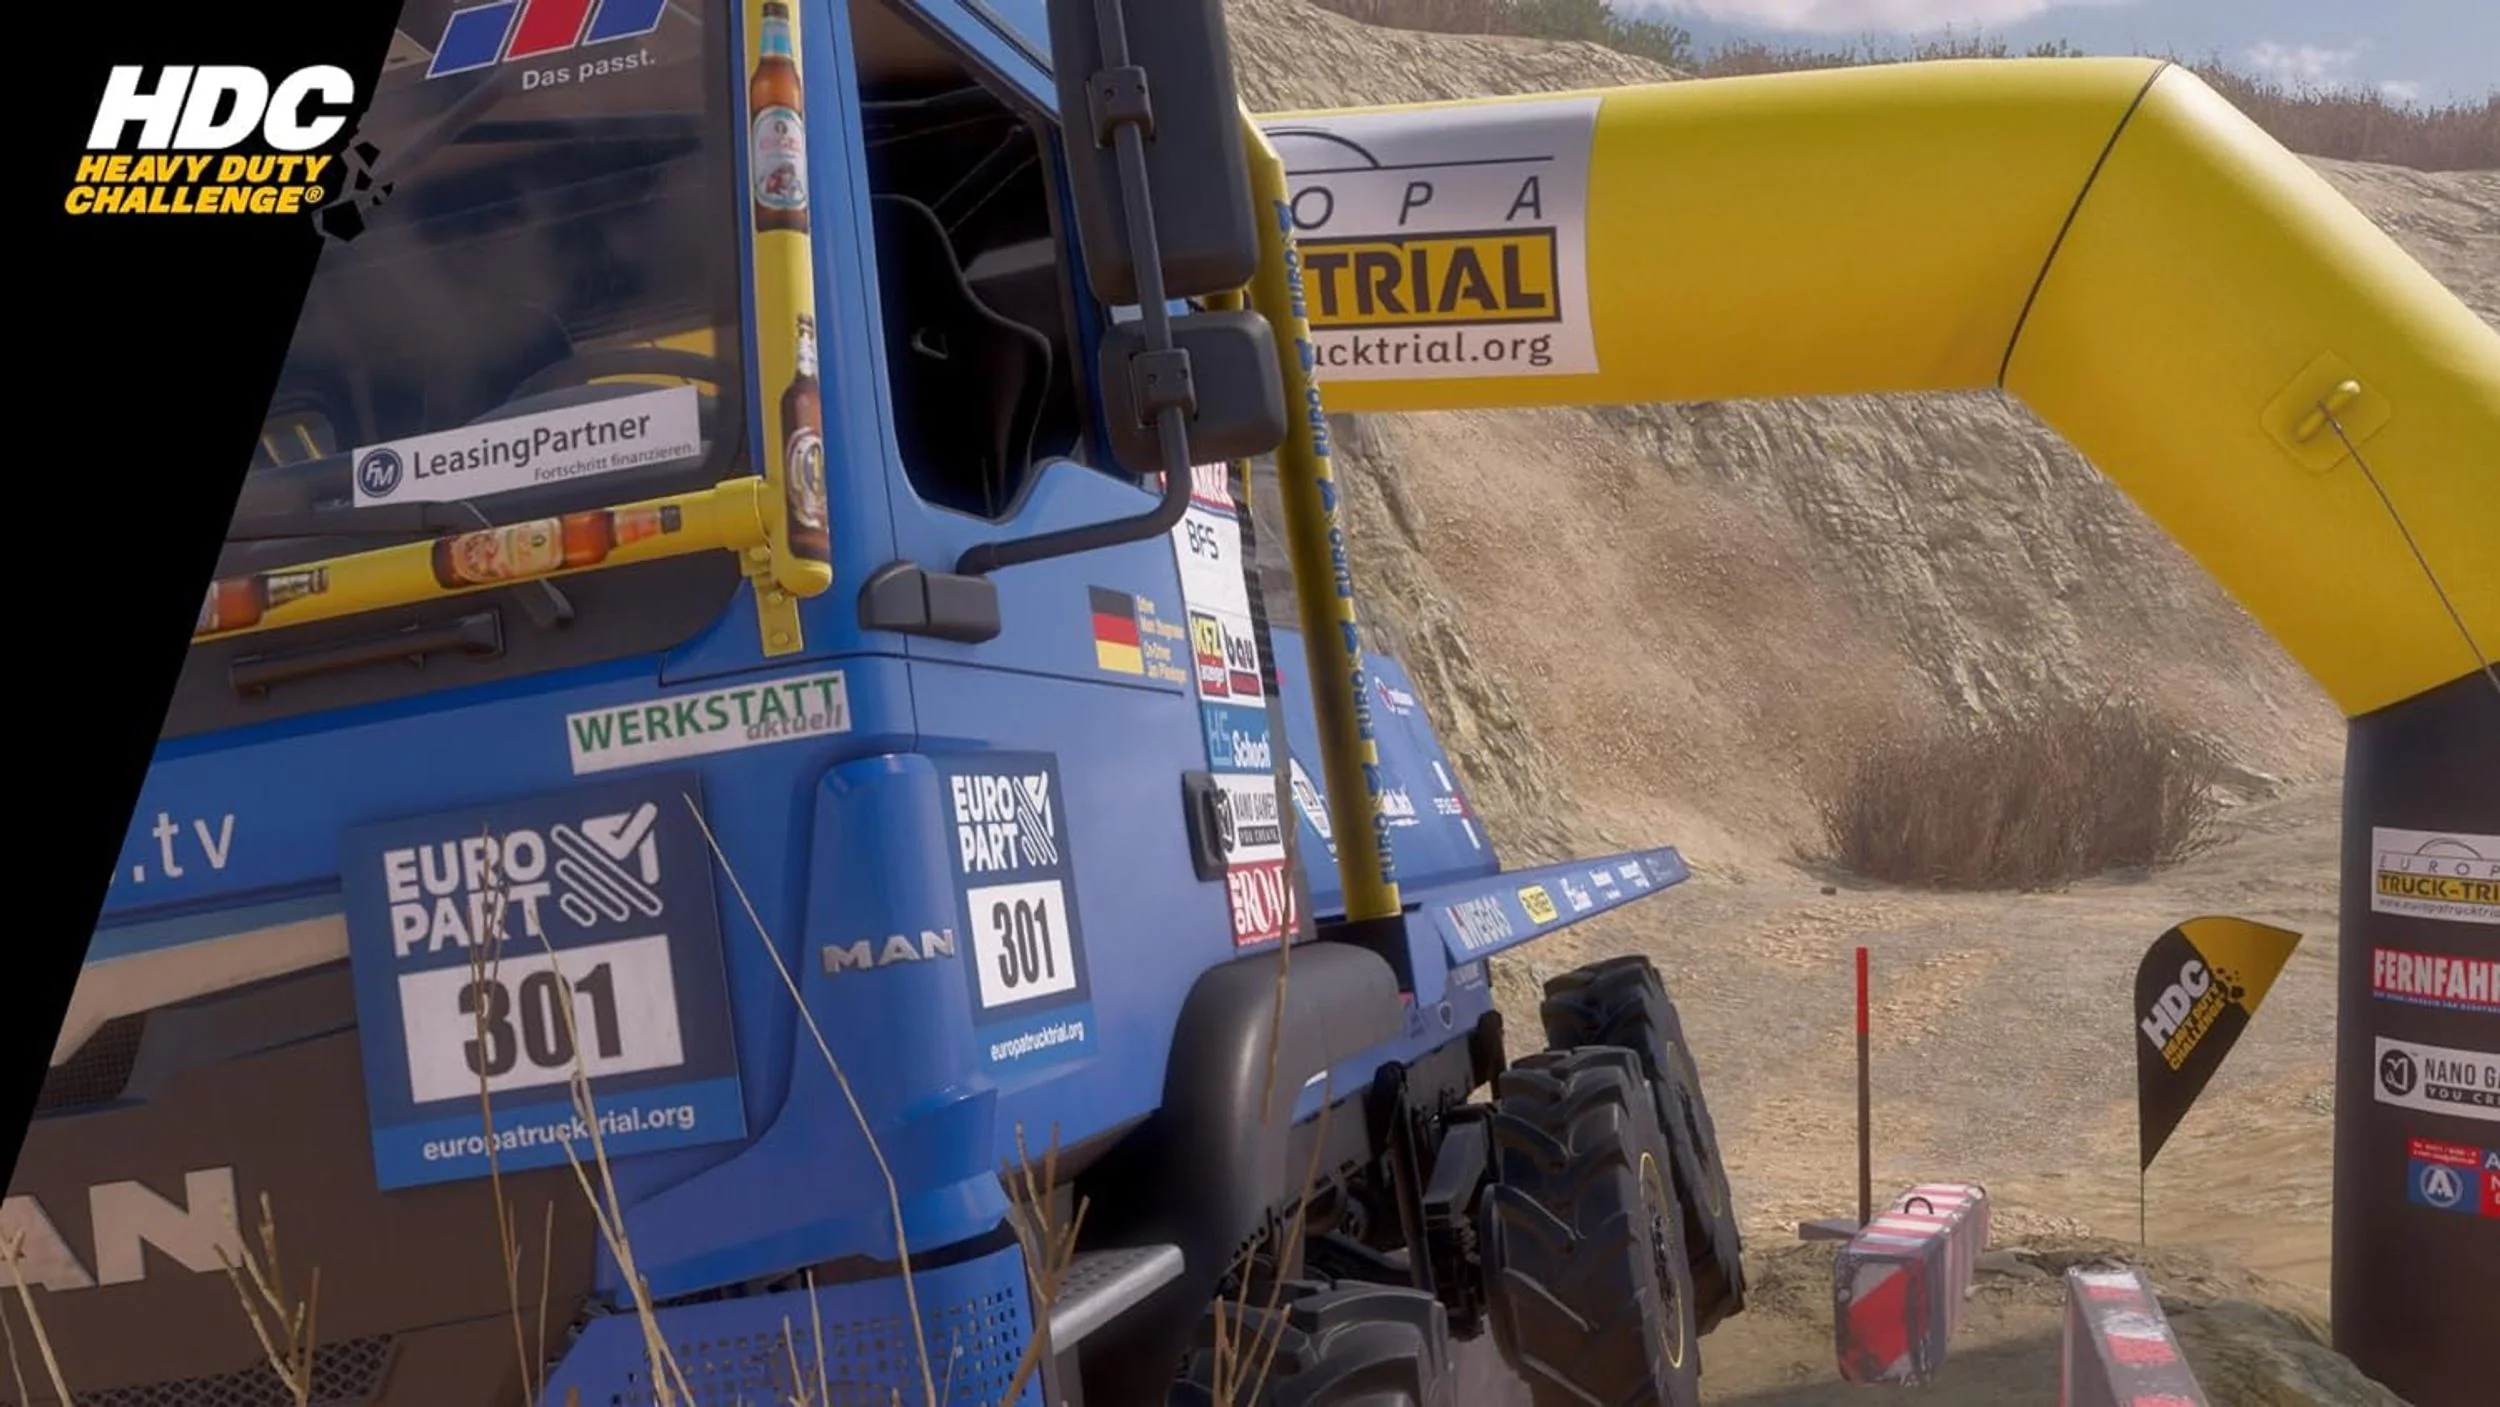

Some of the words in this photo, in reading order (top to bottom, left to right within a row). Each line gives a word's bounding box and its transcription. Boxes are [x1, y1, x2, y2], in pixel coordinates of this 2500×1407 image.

[521, 69, 571, 91] Das
[578, 49, 656, 83] passt.
[1305, 244, 1547, 317] TRIAL
[413, 413, 652, 480] LeasingPartner
[534, 453, 609, 482] Fortschritt
[611, 441, 695, 470] finanzieren.
[1185, 517, 1220, 561] BFS
[573, 676, 841, 753] WERKSTATT
[745, 704, 842, 741] aktuell
[952, 772, 1015, 823] EURO
[110, 811, 236, 883] .tv
[383, 829, 548, 903] EURO
[958, 822, 1019, 873] PART
[392, 881, 552, 959] PART
[991, 897, 1056, 989] 301
[821, 928, 956, 974] MAN
[457, 961, 623, 1078] 301
[2140, 959, 2211, 1050] HDC
[990, 1020, 1085, 1062] europatrucktrial.org
[2424, 1057, 2476, 1087] NANO
[2484, 1066, 2500, 1089] G
[2428, 1086, 2462, 1101] YOU
[2472, 1092, 2500, 1106] CR
[422, 1104, 696, 1161] europatruckrial.org
